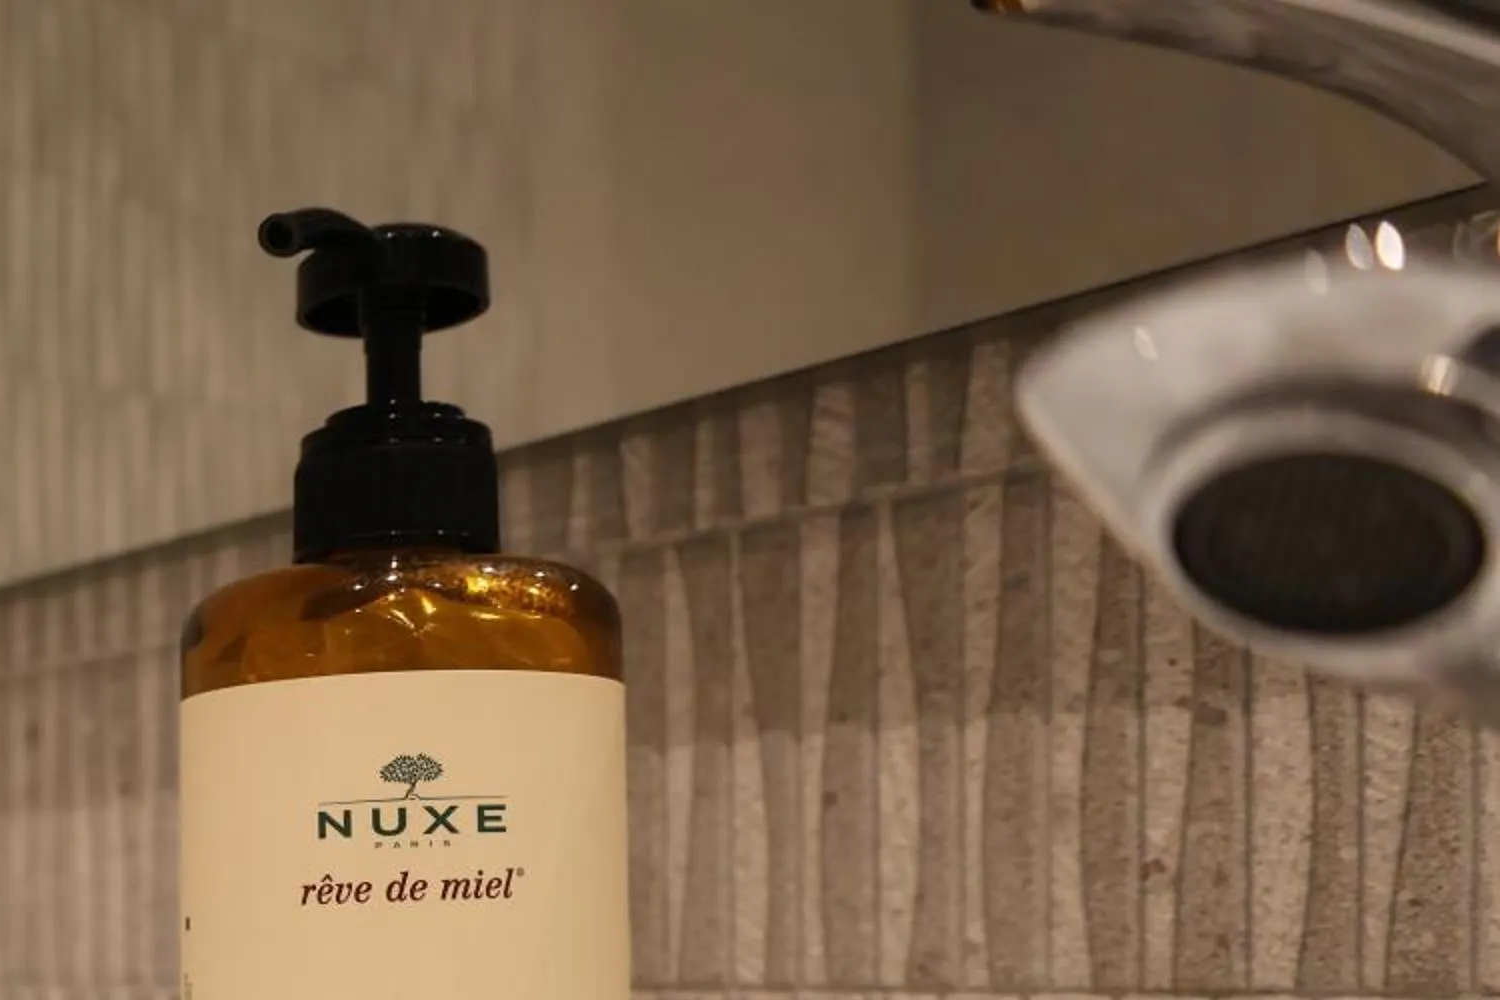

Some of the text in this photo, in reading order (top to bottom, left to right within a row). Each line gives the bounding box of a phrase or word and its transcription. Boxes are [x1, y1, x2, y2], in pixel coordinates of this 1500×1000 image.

[317, 804, 507, 839] NUXE
[374, 840, 451, 849] PARIS
[301, 873, 372, 906] rêve
[386, 871, 428, 901] de
